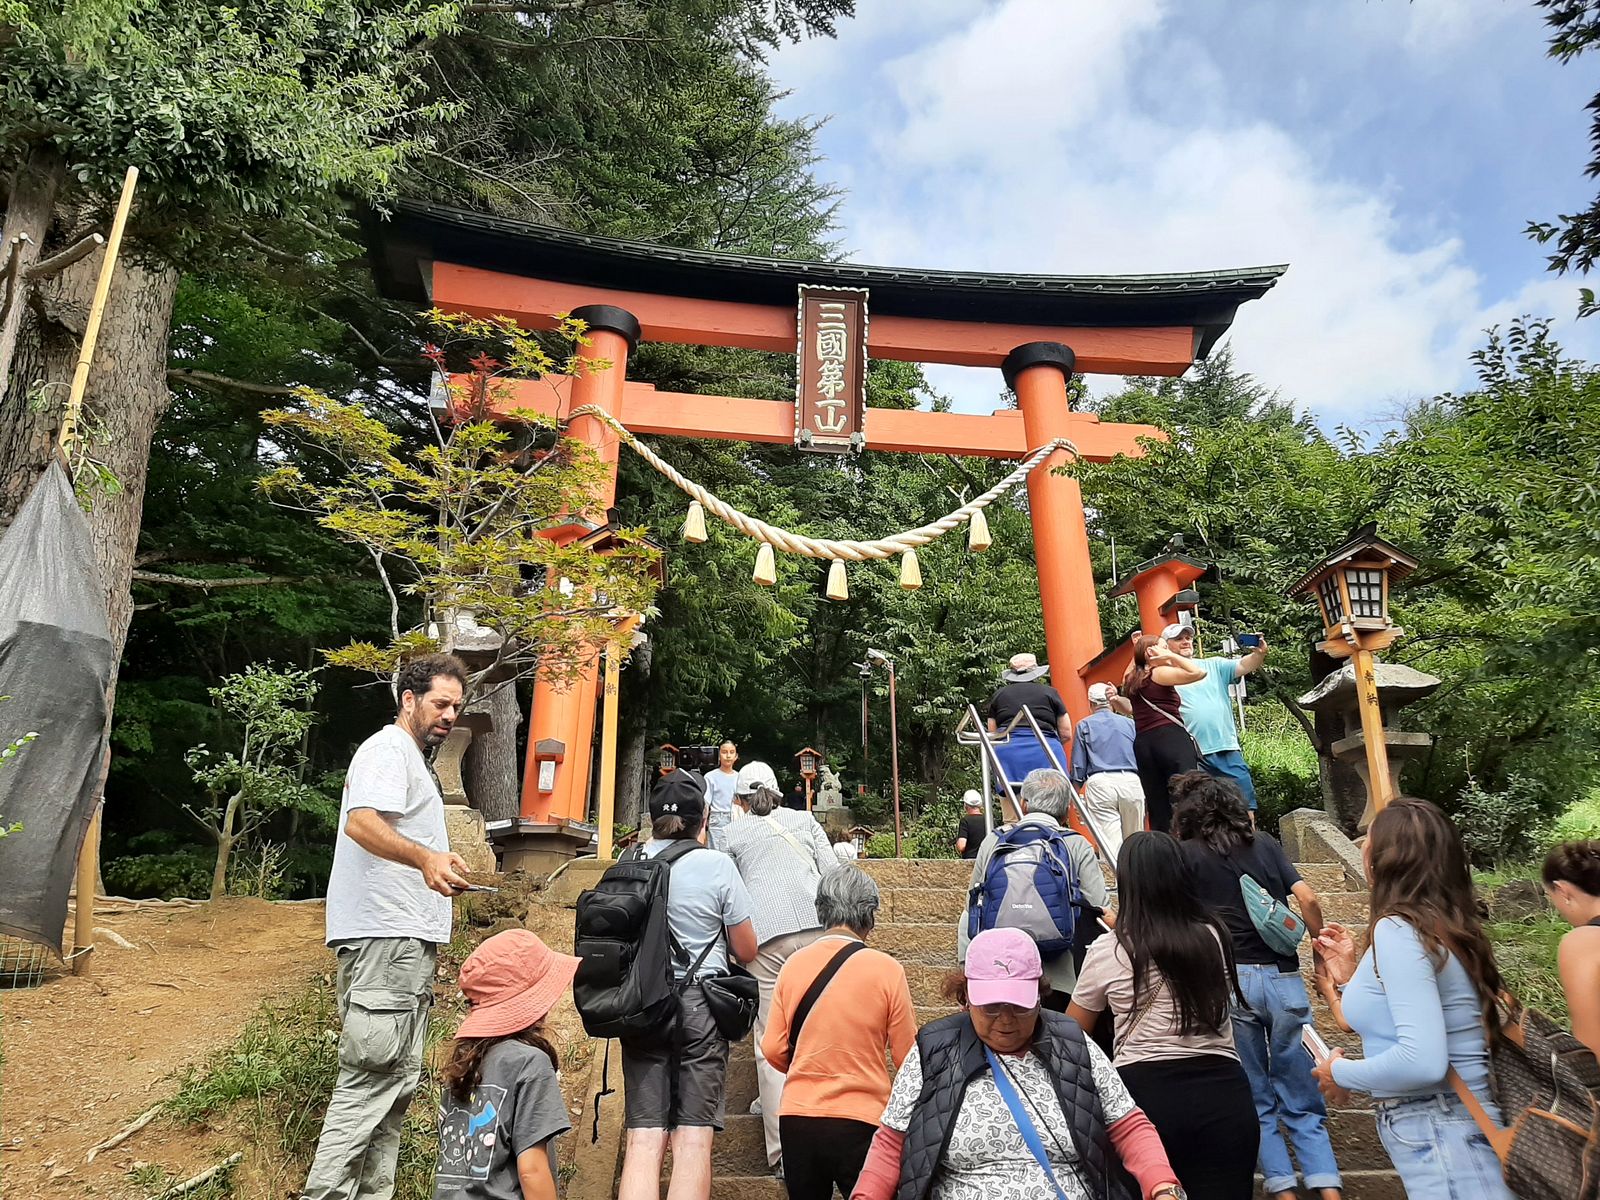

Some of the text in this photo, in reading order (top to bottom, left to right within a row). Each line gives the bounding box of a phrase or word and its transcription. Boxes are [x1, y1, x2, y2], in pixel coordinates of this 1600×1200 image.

[813, 303, 847, 433] 三國第一山
